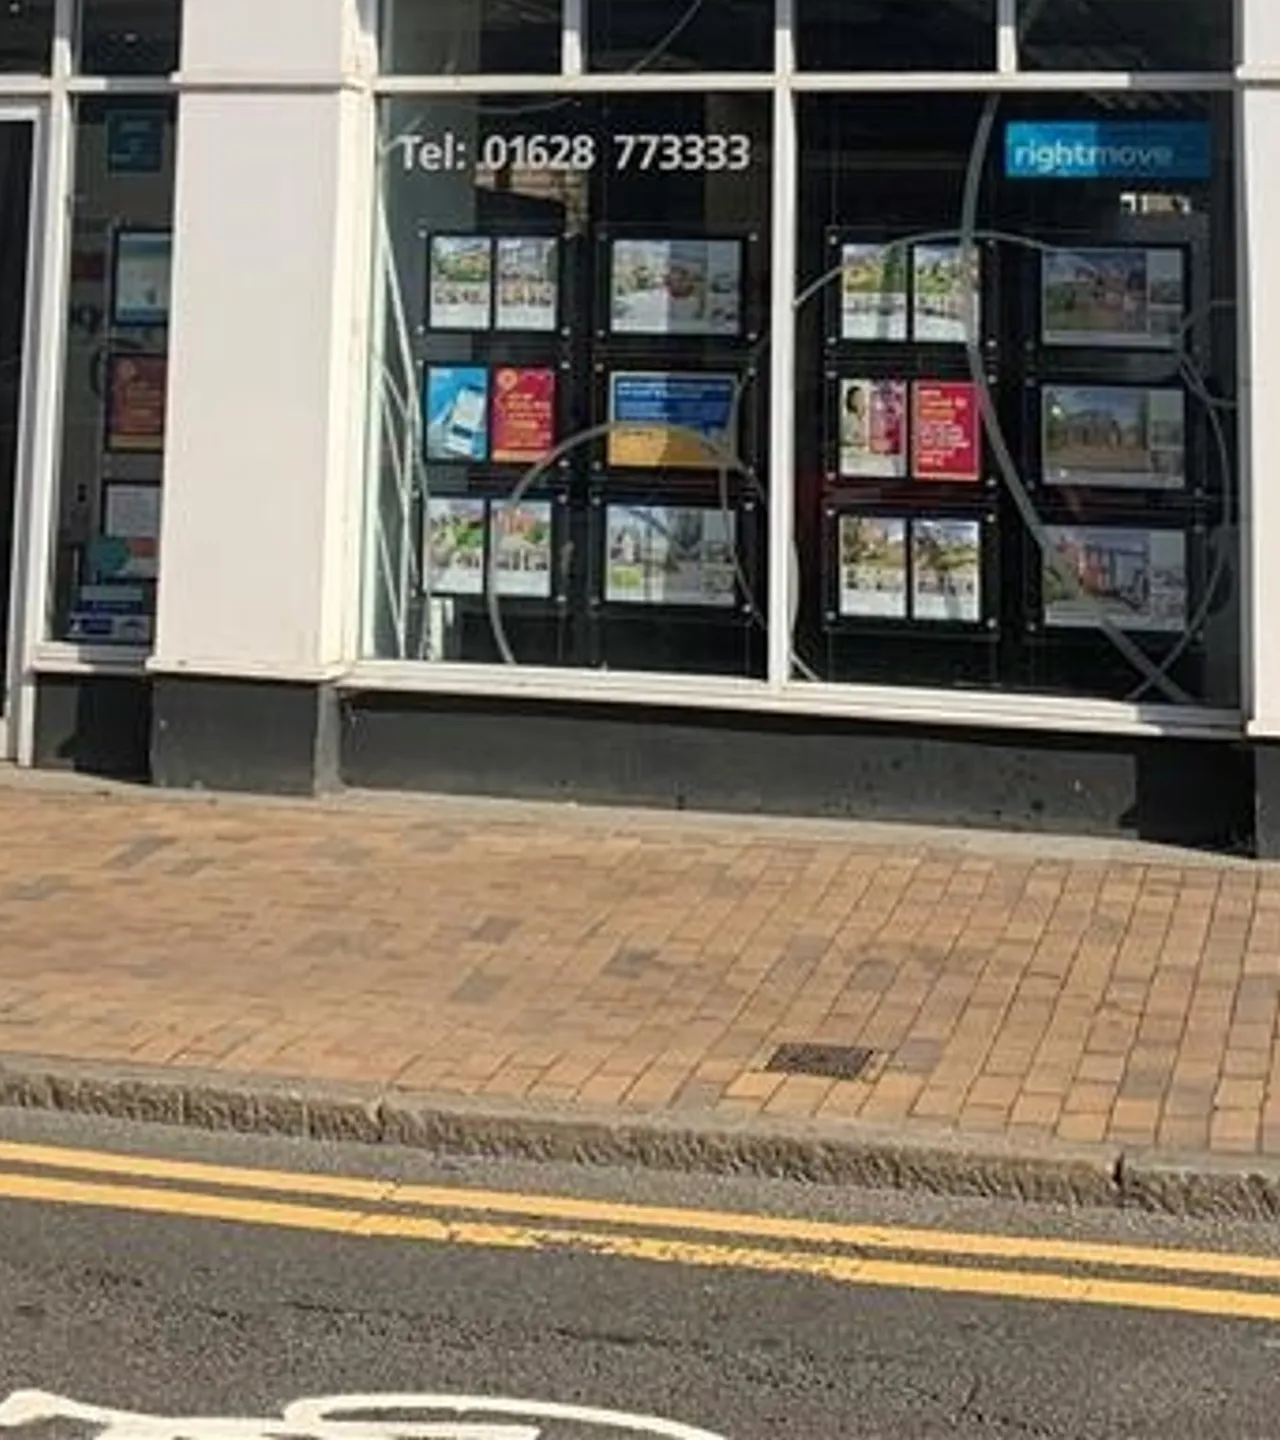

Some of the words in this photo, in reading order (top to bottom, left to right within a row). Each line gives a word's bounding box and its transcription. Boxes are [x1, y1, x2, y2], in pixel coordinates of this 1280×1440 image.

[400, 133, 466, 171] Tel:
[482, 133, 595, 172] 01628
[614, 133, 752, 172] 773333
[1015, 138, 1172, 173] rightmove
